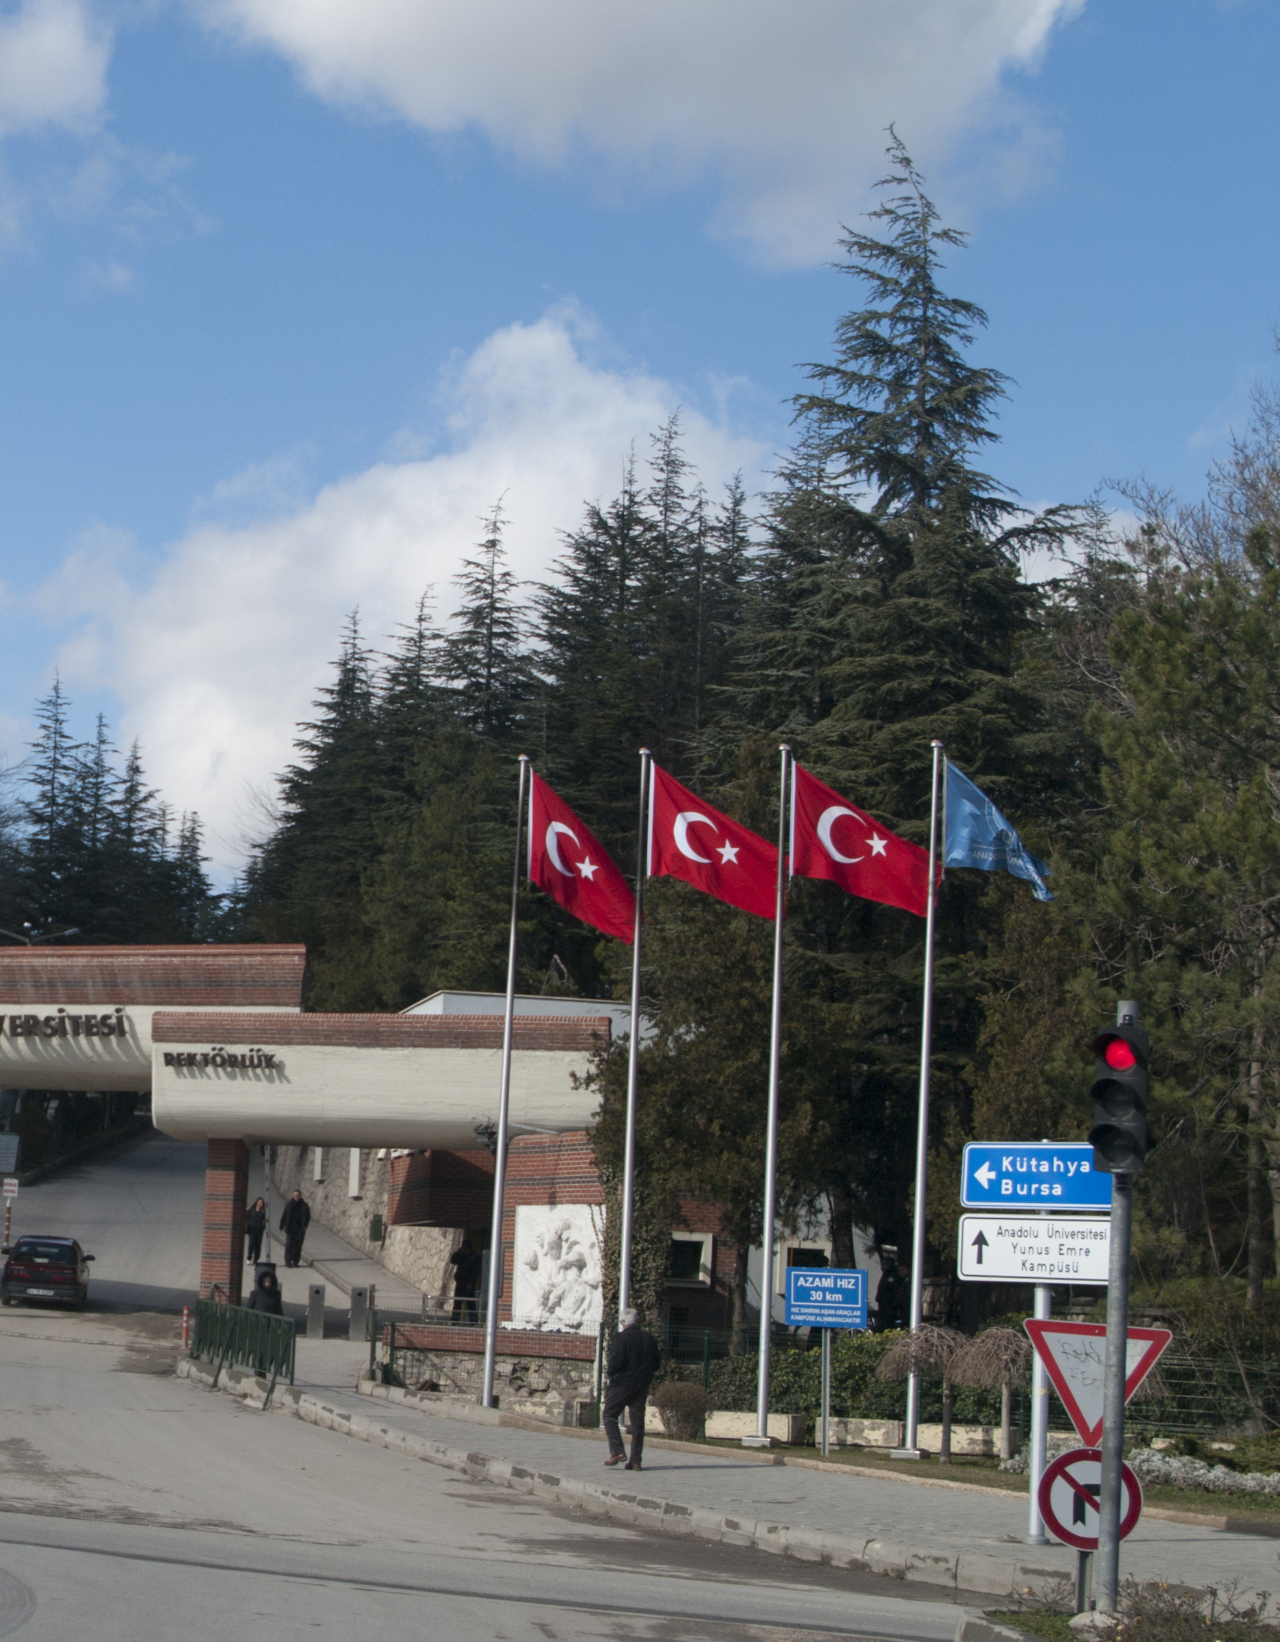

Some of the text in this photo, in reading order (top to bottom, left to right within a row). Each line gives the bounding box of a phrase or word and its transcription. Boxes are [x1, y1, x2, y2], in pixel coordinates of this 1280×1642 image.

[163, 1046, 276, 1069] REKTÖRLÜK
[1002, 1156, 1090, 1177] Kütahya
[1001, 1179, 1062, 1195] Bursa
[996, 1223, 1107, 1240] Anadolu Üniversitesi
[1011, 1242, 1091, 1256] Yunus Emre
[1021, 1259, 1079, 1275] Kampüsü
[797, 1275, 856, 1289] AZAMİ HIZ
[810, 1290, 842, 1302] 30 km
[835, 1309, 861, 1317] ARAÇLAR
